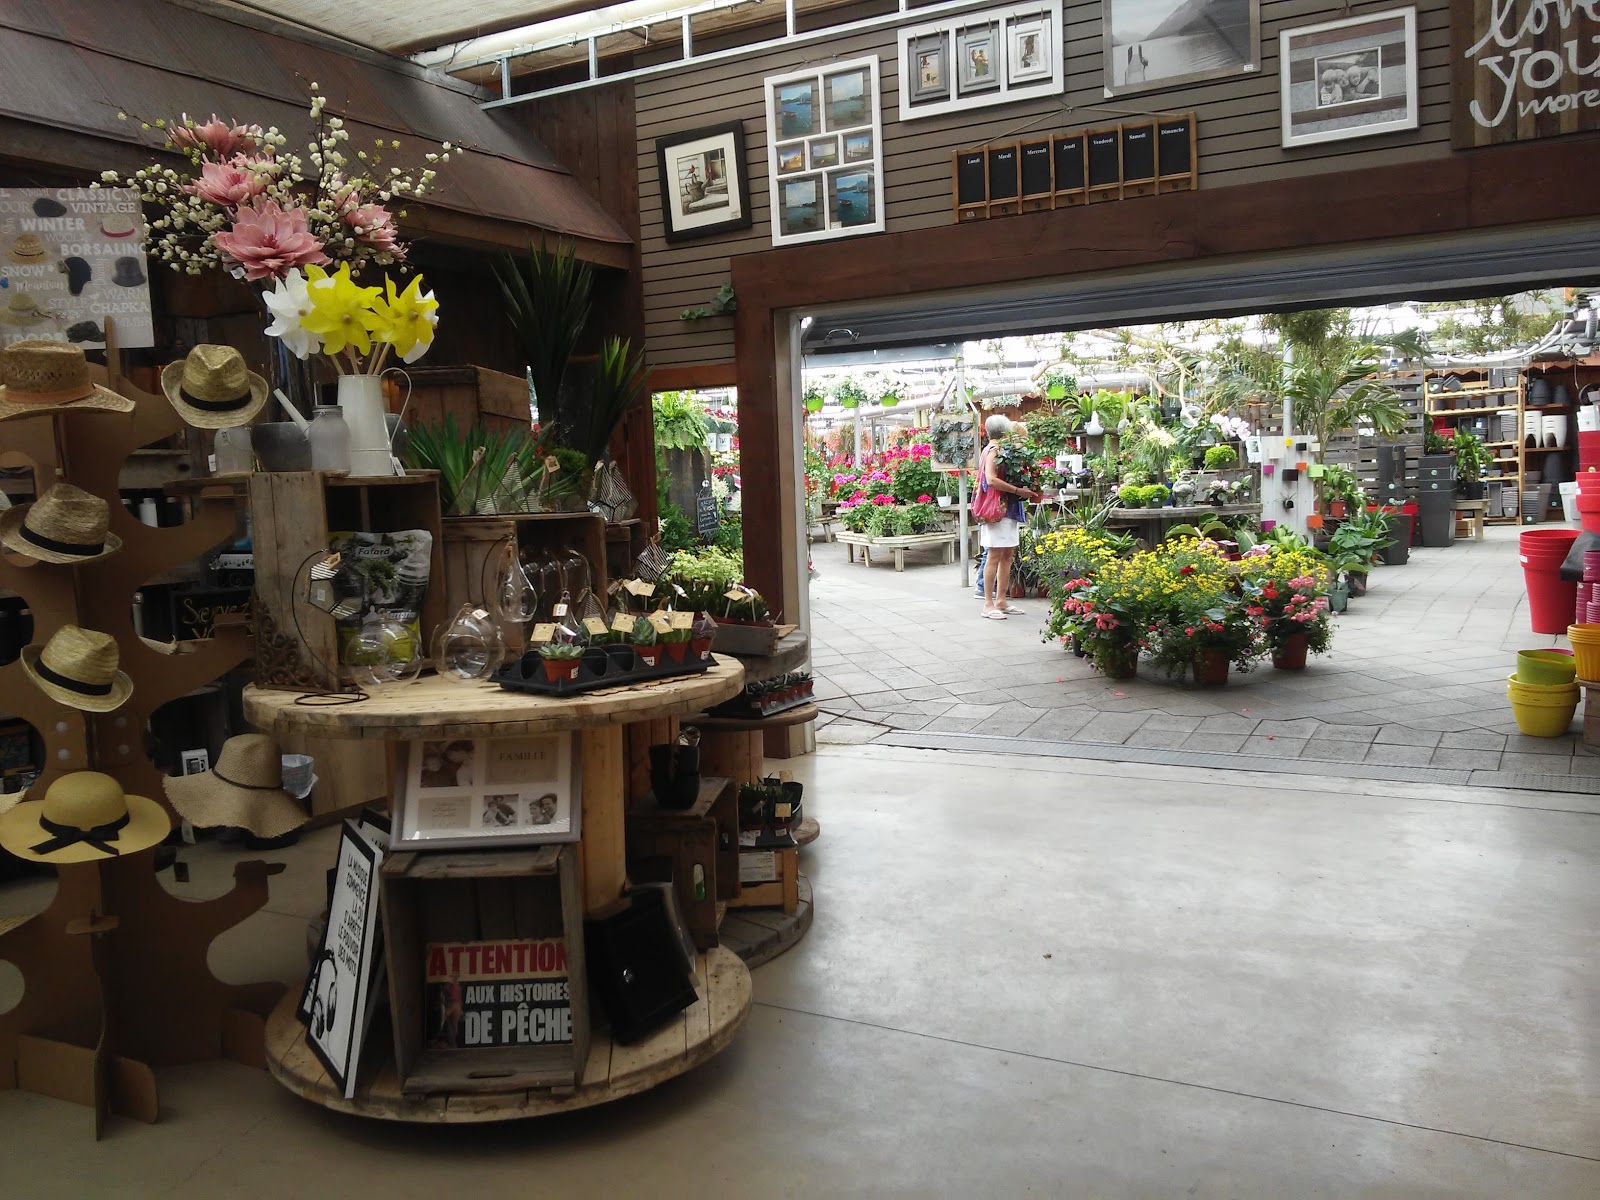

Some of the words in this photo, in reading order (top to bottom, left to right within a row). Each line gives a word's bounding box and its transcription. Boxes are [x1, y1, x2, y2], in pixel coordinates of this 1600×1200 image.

[1469, 34, 1600, 128] you
[1517, 89, 1600, 118] more
[1128, 132, 1146, 141] Samedi
[1160, 127, 1184, 136] Dimanche
[1062, 143, 1076, 151] Jeudi
[1092, 138, 1114, 146] Vendredi
[997, 152, 1012, 160] Mardi
[1026, 147, 1047, 156] Mercredi
[56, 188, 122, 201] CLASSIC
[70, 203, 136, 214] VINTAGE
[20, 218, 85, 231] WINTER
[1, 266, 45, 277] SNOW
[103, 288, 148, 300] WARM
[90, 302, 149, 314] CHAPKA
[358, 547, 391, 555] Fafard
[499, 752, 546, 761] FAMILLE
[428, 941, 568, 977] ATTENTION
[465, 984, 496, 1004] AUX
[499, 982, 570, 1004] HISTOIRES
[464, 1010, 493, 1046] DE
[501, 1002, 573, 1043] PÊCHE
